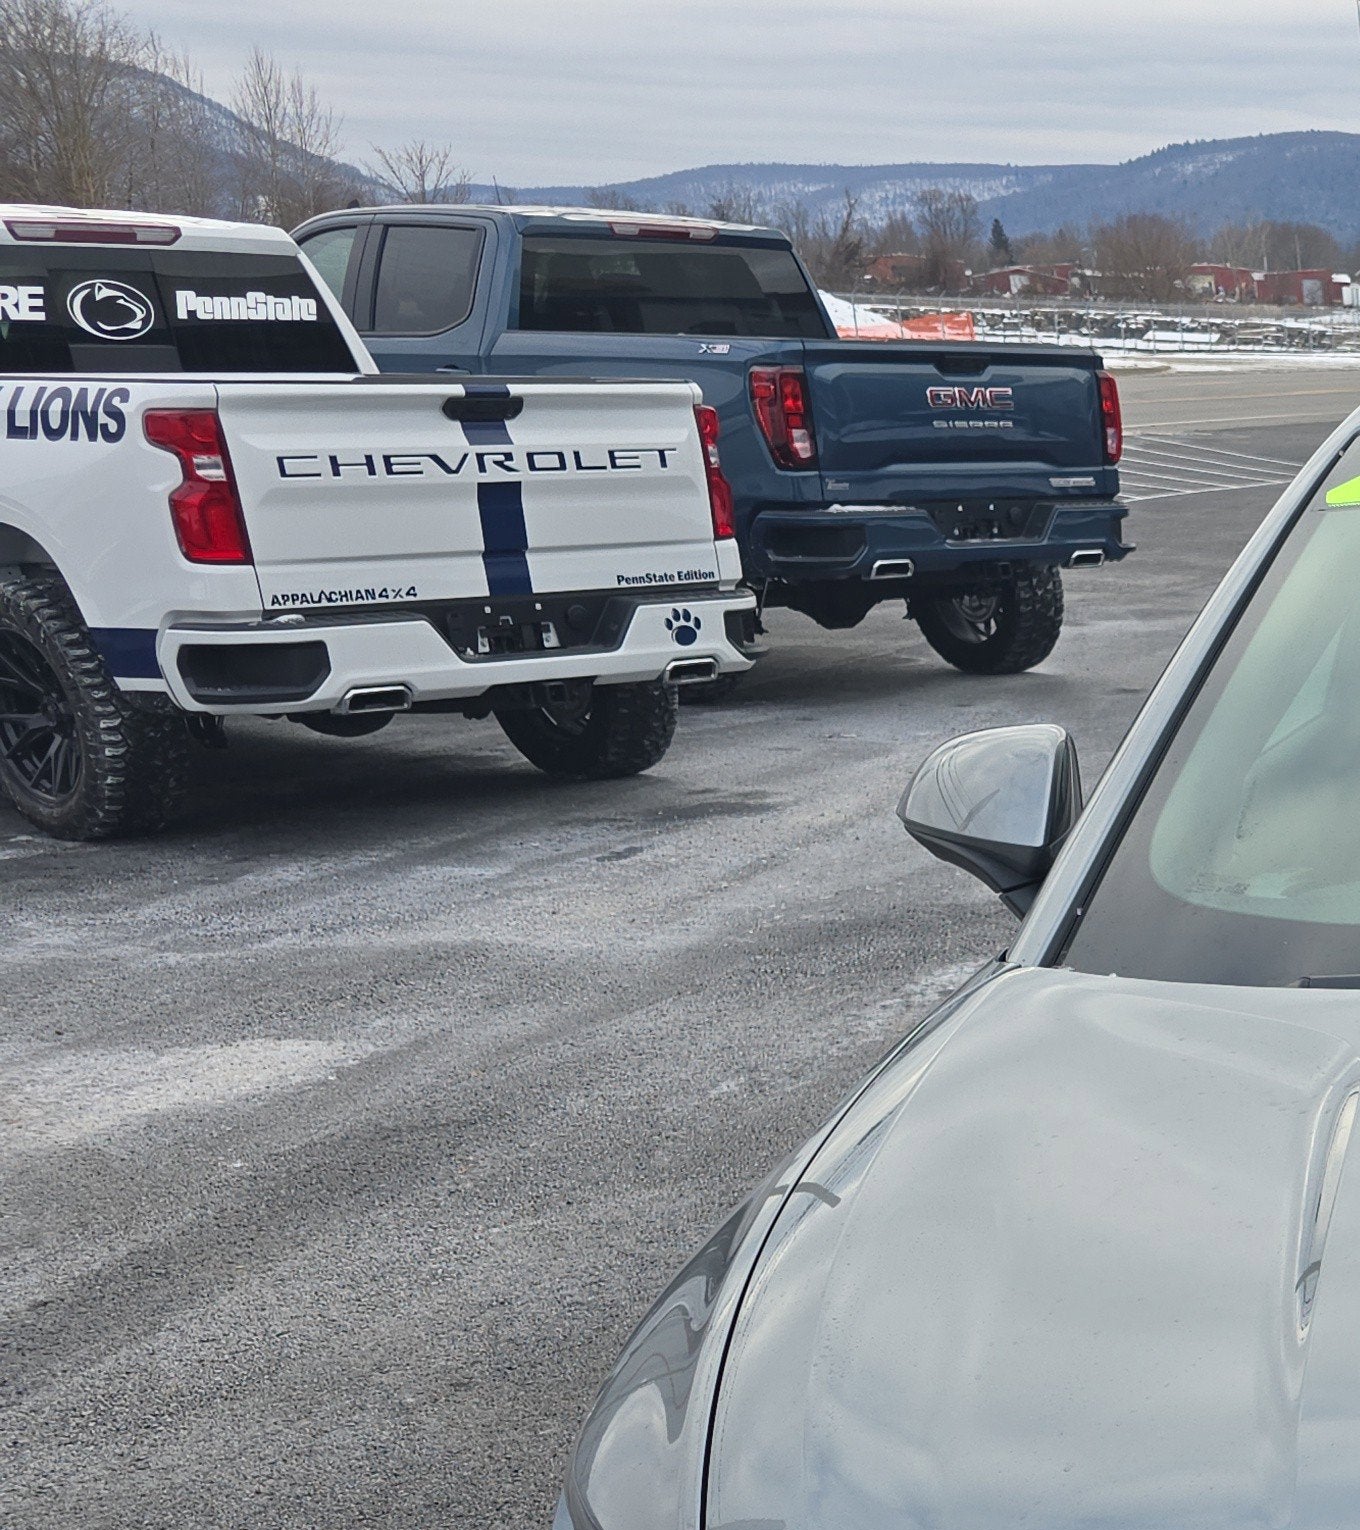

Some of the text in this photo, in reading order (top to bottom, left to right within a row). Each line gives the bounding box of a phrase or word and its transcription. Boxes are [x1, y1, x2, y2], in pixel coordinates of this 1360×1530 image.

[175, 290, 317, 321] PennState
[926, 386, 1014, 410] GMC
[6, 386, 130, 443] LIONS
[276, 447, 677, 479] CHEVROLET
[616, 569, 715, 586] PennState Edition
[270, 588, 376, 607] APPALACHIAN
